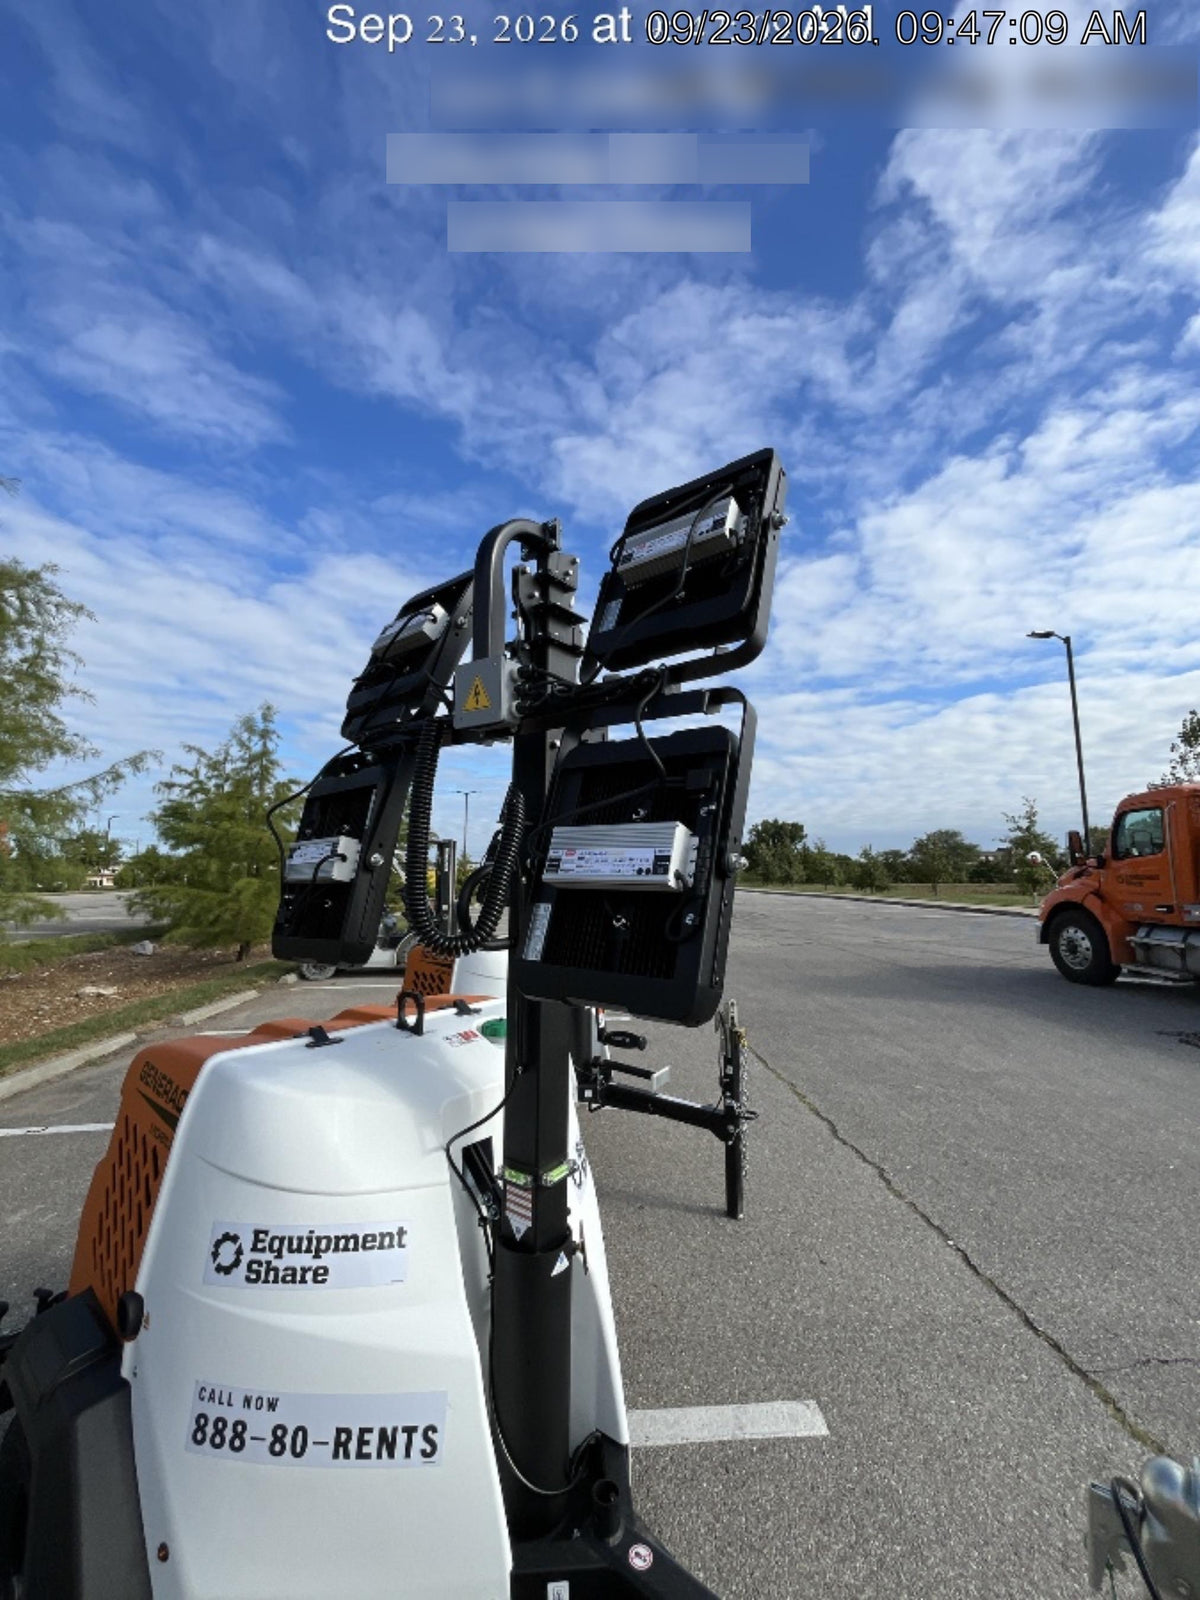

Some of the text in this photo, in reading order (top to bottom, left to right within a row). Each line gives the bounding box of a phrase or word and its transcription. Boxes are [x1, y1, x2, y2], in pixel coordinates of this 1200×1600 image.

[250, 1226, 408, 1259] Equipment
[245, 1259, 330, 1285] Share
[198, 1386, 279, 1412] CALL NOW
[191, 1412, 439, 1461] 888-80-RENTS
